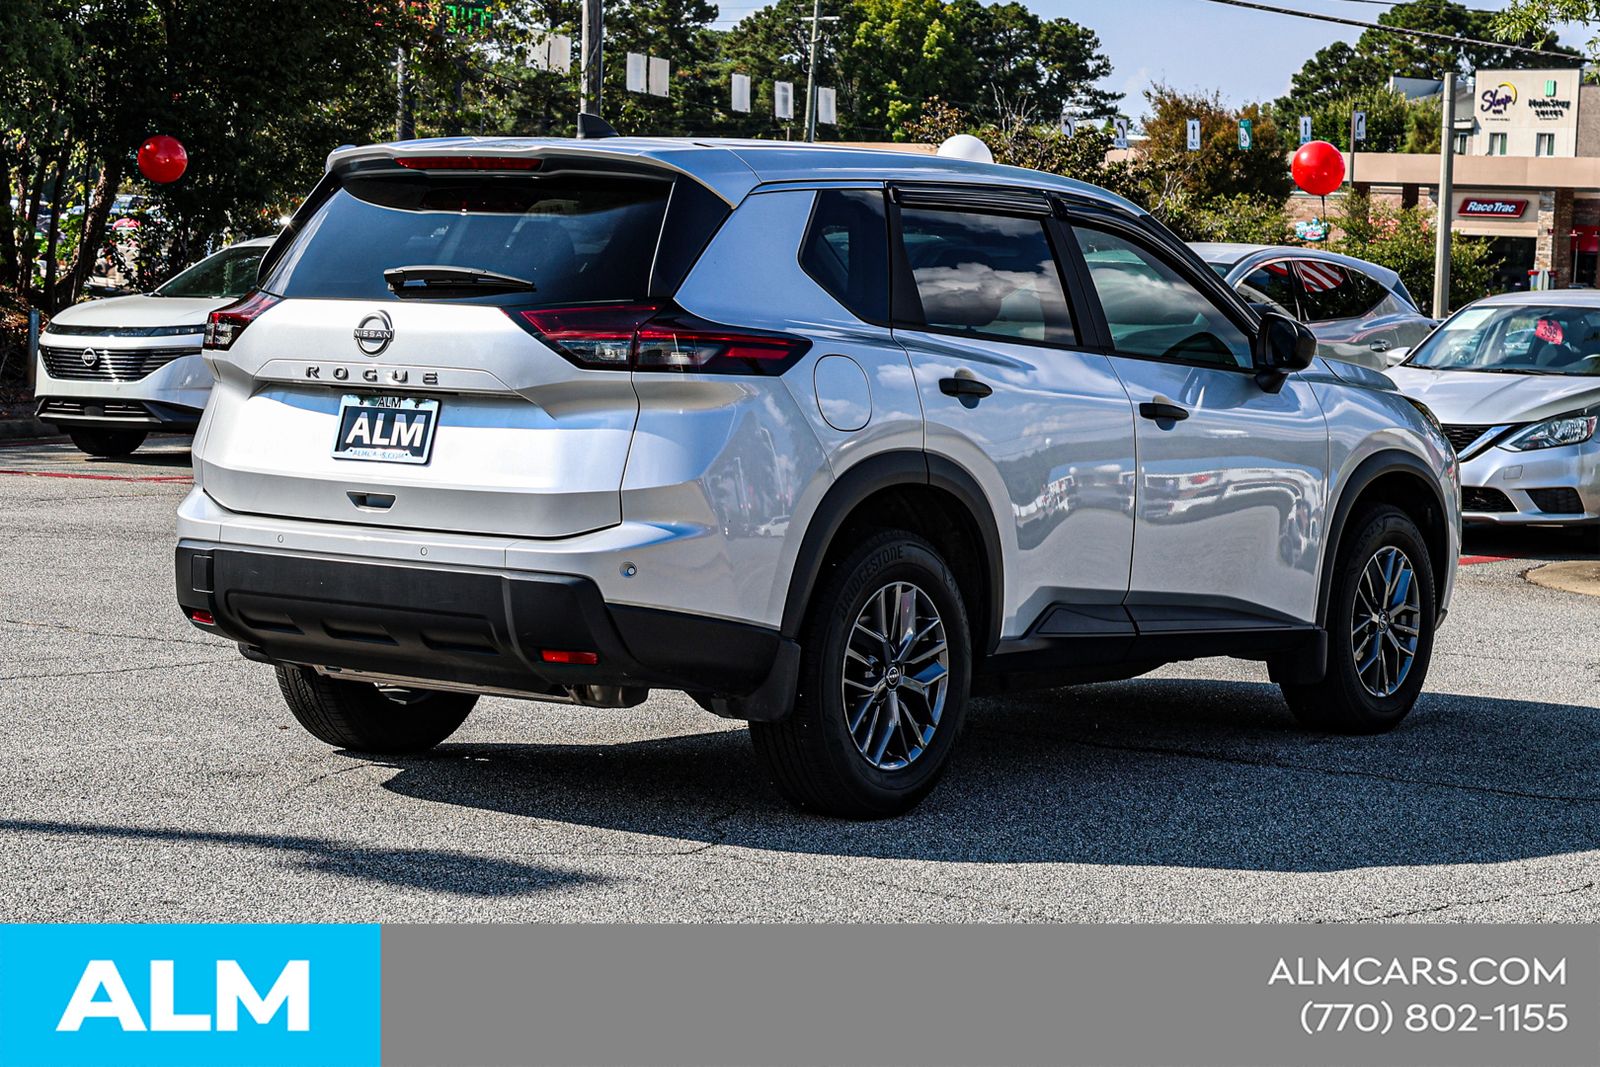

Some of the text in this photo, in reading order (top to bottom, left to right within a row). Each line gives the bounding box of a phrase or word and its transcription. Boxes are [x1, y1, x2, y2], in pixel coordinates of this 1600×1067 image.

[1480, 89, 1513, 112] Sleep
[1466, 201, 1517, 213] RaceTrac
[354, 330, 392, 339] NISSAN
[305, 366, 439, 385] ROGUE
[376, 396, 402, 408] ALM
[345, 411, 427, 448] ALM
